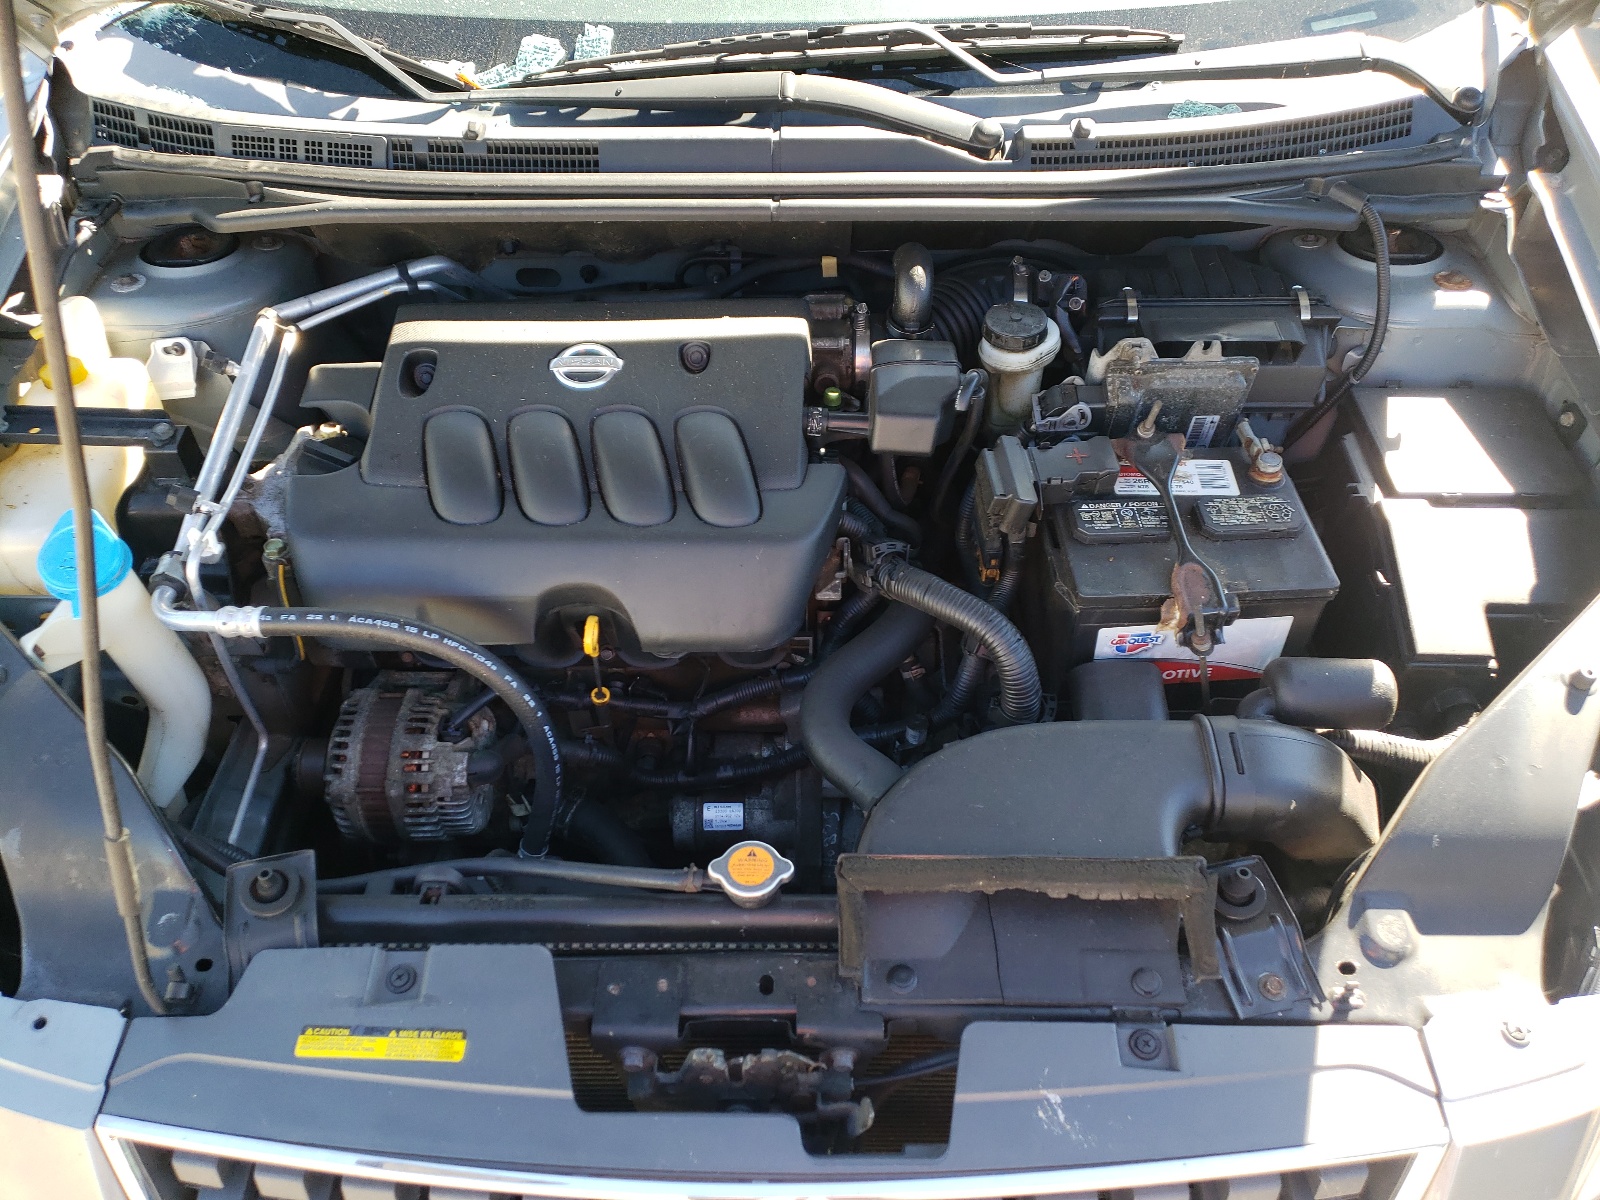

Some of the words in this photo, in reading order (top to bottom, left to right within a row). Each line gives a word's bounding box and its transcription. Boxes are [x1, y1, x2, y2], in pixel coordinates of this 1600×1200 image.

[557, 356, 613, 367] NISSAN
[422, 630, 439, 639] LP
[1110, 634, 1162, 647] CARQUEST
[313, 1027, 351, 1036] CAUTION
[398, 1029, 419, 1038] MISE
[420, 1030, 433, 1038] EN
